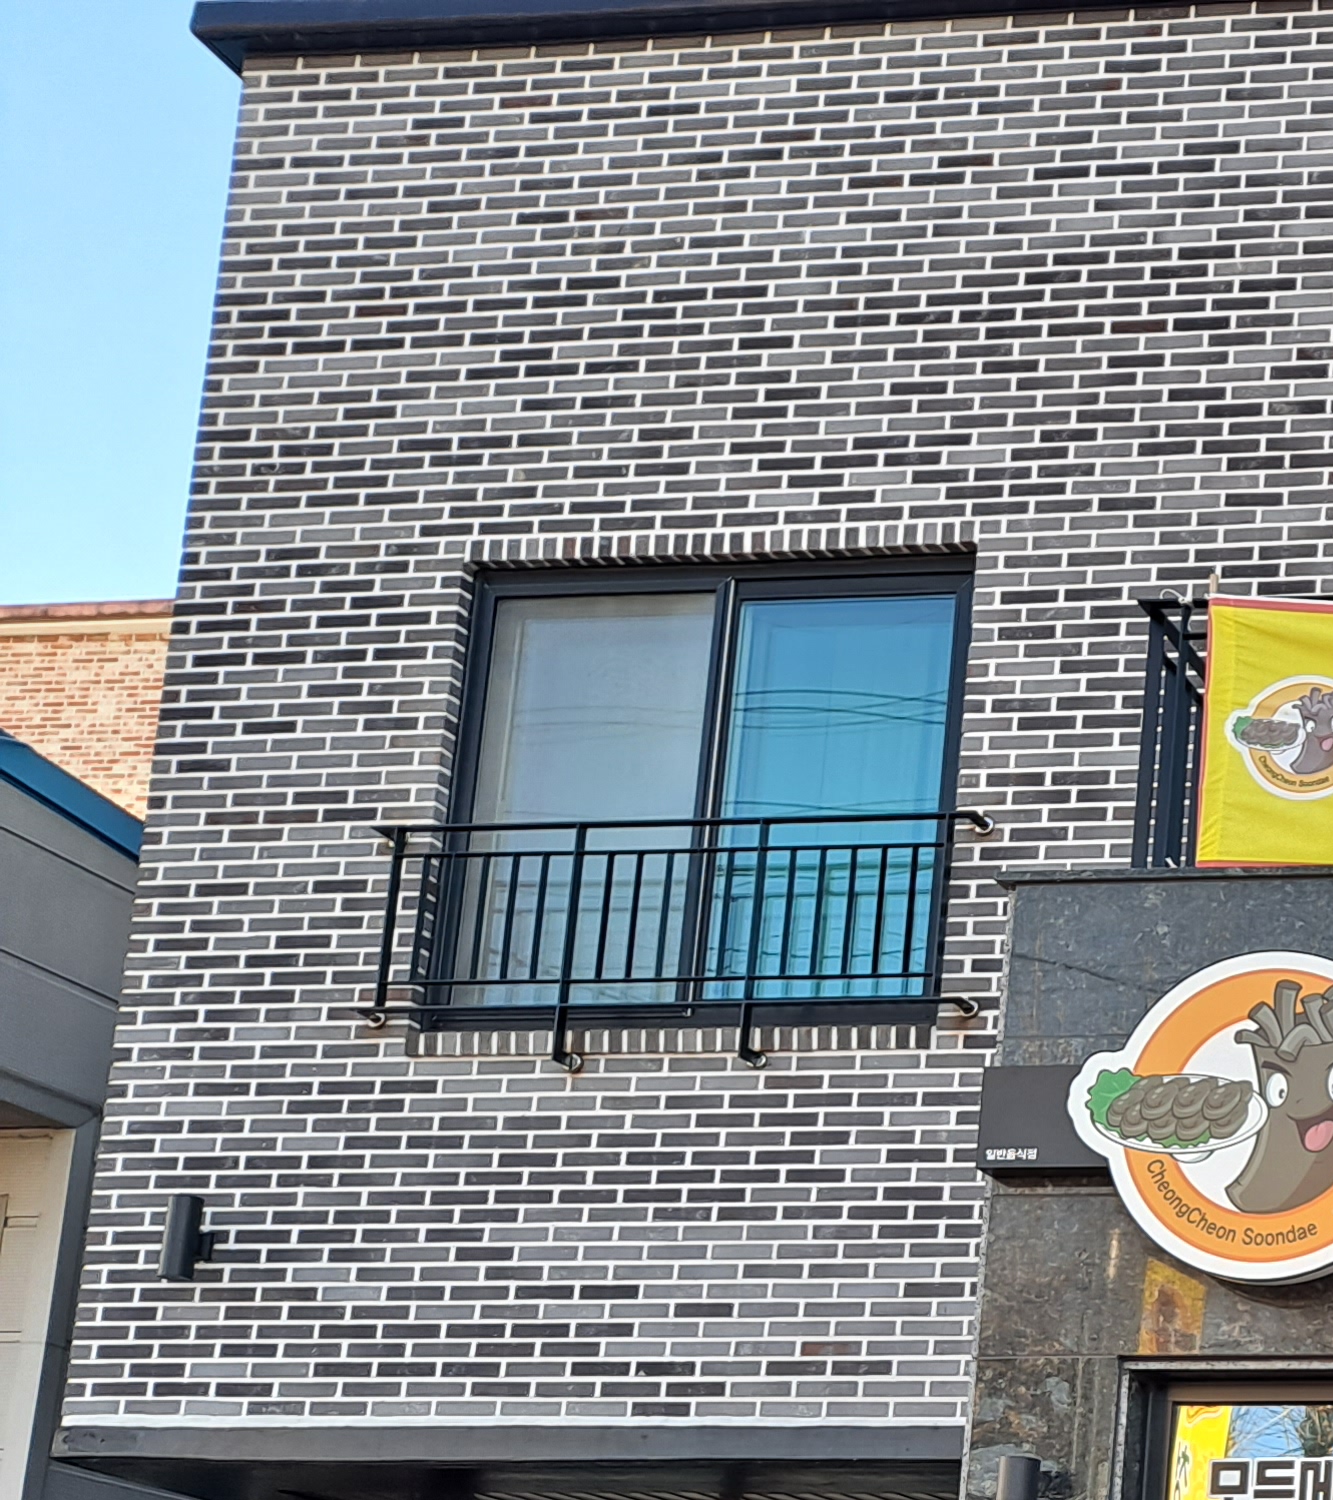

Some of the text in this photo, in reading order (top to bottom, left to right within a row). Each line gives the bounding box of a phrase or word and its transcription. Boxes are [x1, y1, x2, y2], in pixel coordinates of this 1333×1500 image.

[985, 1147, 1038, 1161] 일반음식점
[1146, 1158, 1237, 1244] CheongCheon
[1241, 1221, 1319, 1248] Soondae
